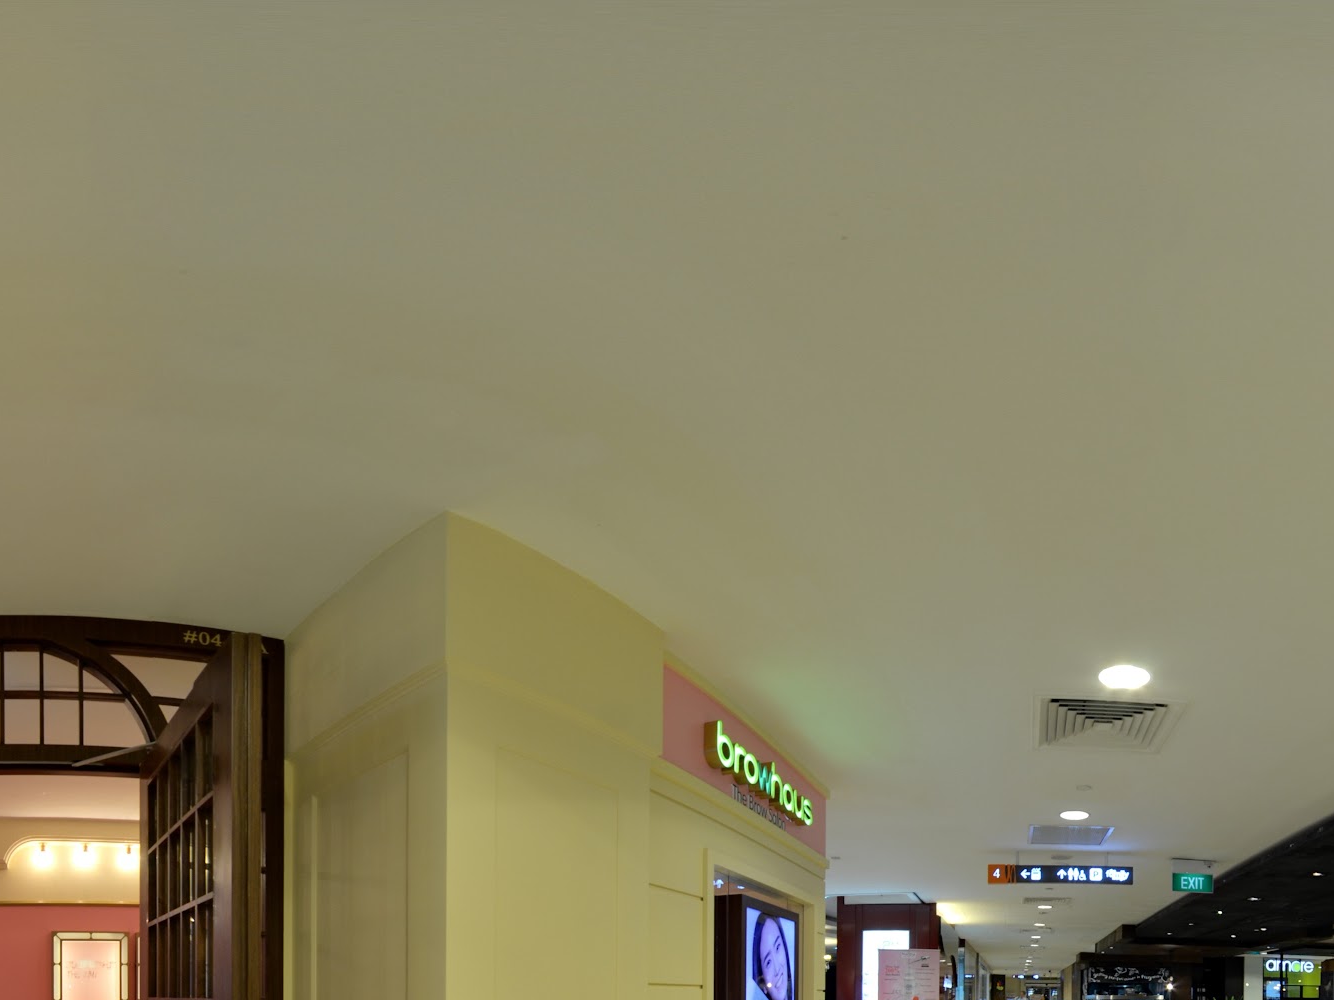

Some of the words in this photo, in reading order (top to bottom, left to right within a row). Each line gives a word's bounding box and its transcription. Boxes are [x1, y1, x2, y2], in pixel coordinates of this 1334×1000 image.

[183, 630, 222, 647] #04
[716, 720, 813, 826] browhaus
[731, 783, 747, 806] The
[747, 794, 767, 819] Brow
[767, 808, 786, 831] Salon
[993, 868, 1001, 879] 4
[1180, 876, 1205, 890] EXIT
